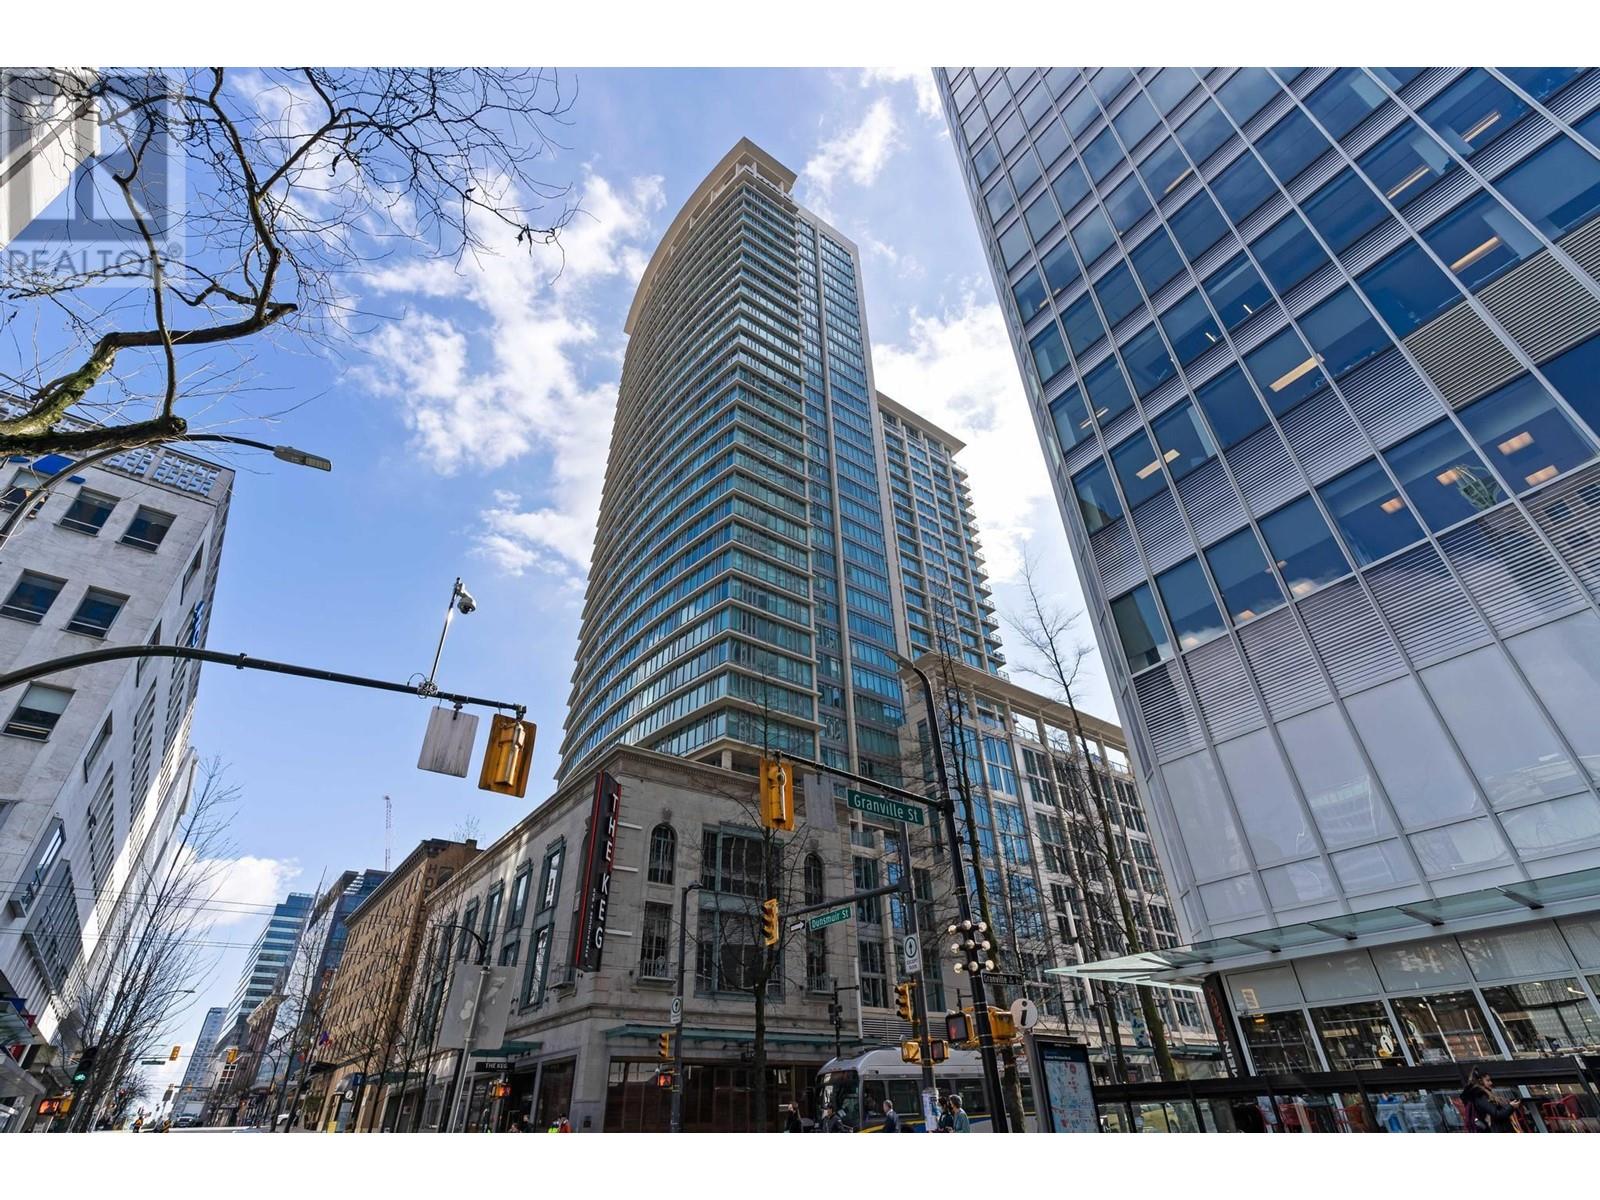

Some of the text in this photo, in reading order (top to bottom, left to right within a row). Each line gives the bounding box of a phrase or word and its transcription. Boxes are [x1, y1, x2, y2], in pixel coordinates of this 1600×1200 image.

[854, 795, 919, 822] Granville St
[595, 793, 619, 949] THE KEG
[811, 909, 849, 929] Dunsmuir St
